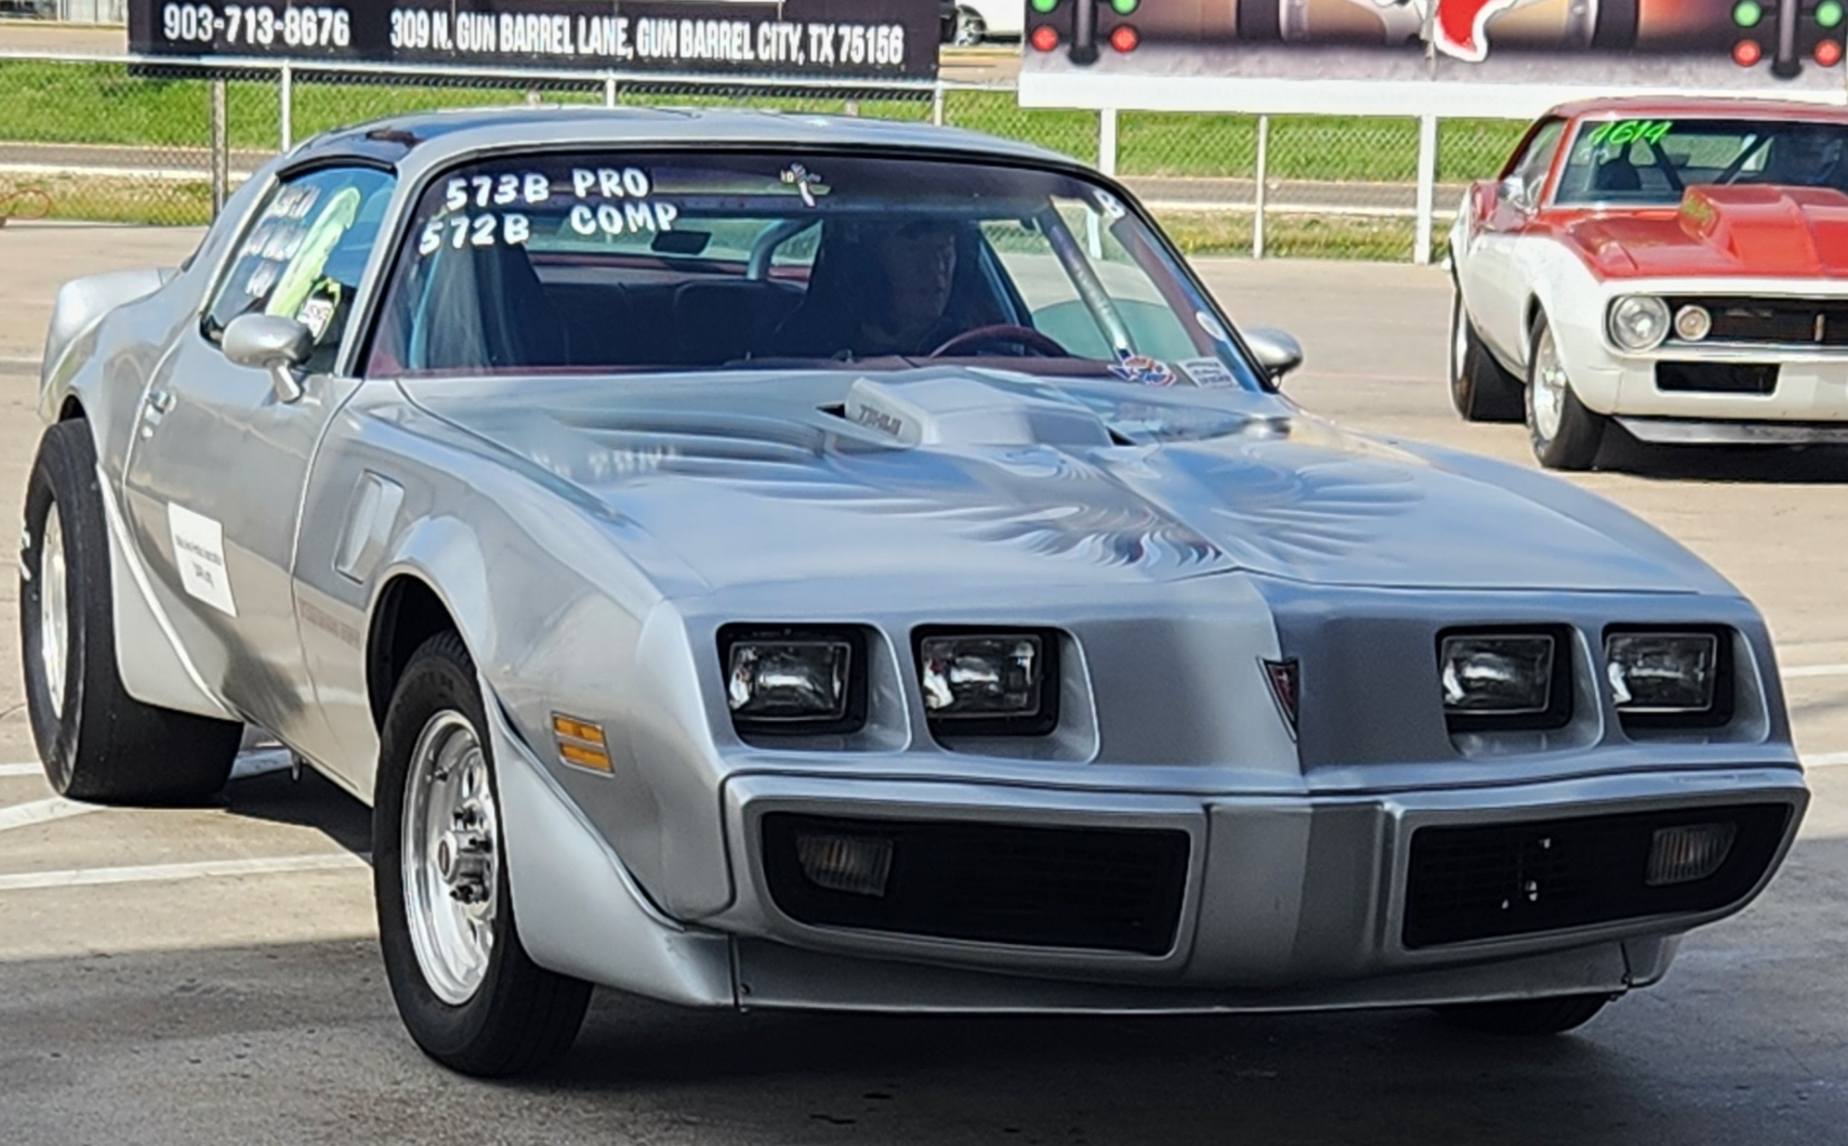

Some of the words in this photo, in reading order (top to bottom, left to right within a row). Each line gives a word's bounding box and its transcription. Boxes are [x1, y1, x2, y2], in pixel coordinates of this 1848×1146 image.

[163, 3, 350, 46] 903-713-8676
[390, 10, 429, 48] 309
[431, 18, 453, 51] N.
[456, 15, 496, 53] GUN
[501, 13, 574, 54] BARREL
[578, 17, 634, 60] LANE,
[636, 20, 678, 57] GUN
[680, 22, 755, 61] BARREL
[758, 25, 804, 65] CITY,
[808, 24, 836, 64] TX
[839, 26, 903, 64] 75156
[446, 173, 549, 210] 573B
[572, 168, 648, 198] PRO
[419, 213, 529, 255] 572B
[570, 203, 677, 235] COMP
